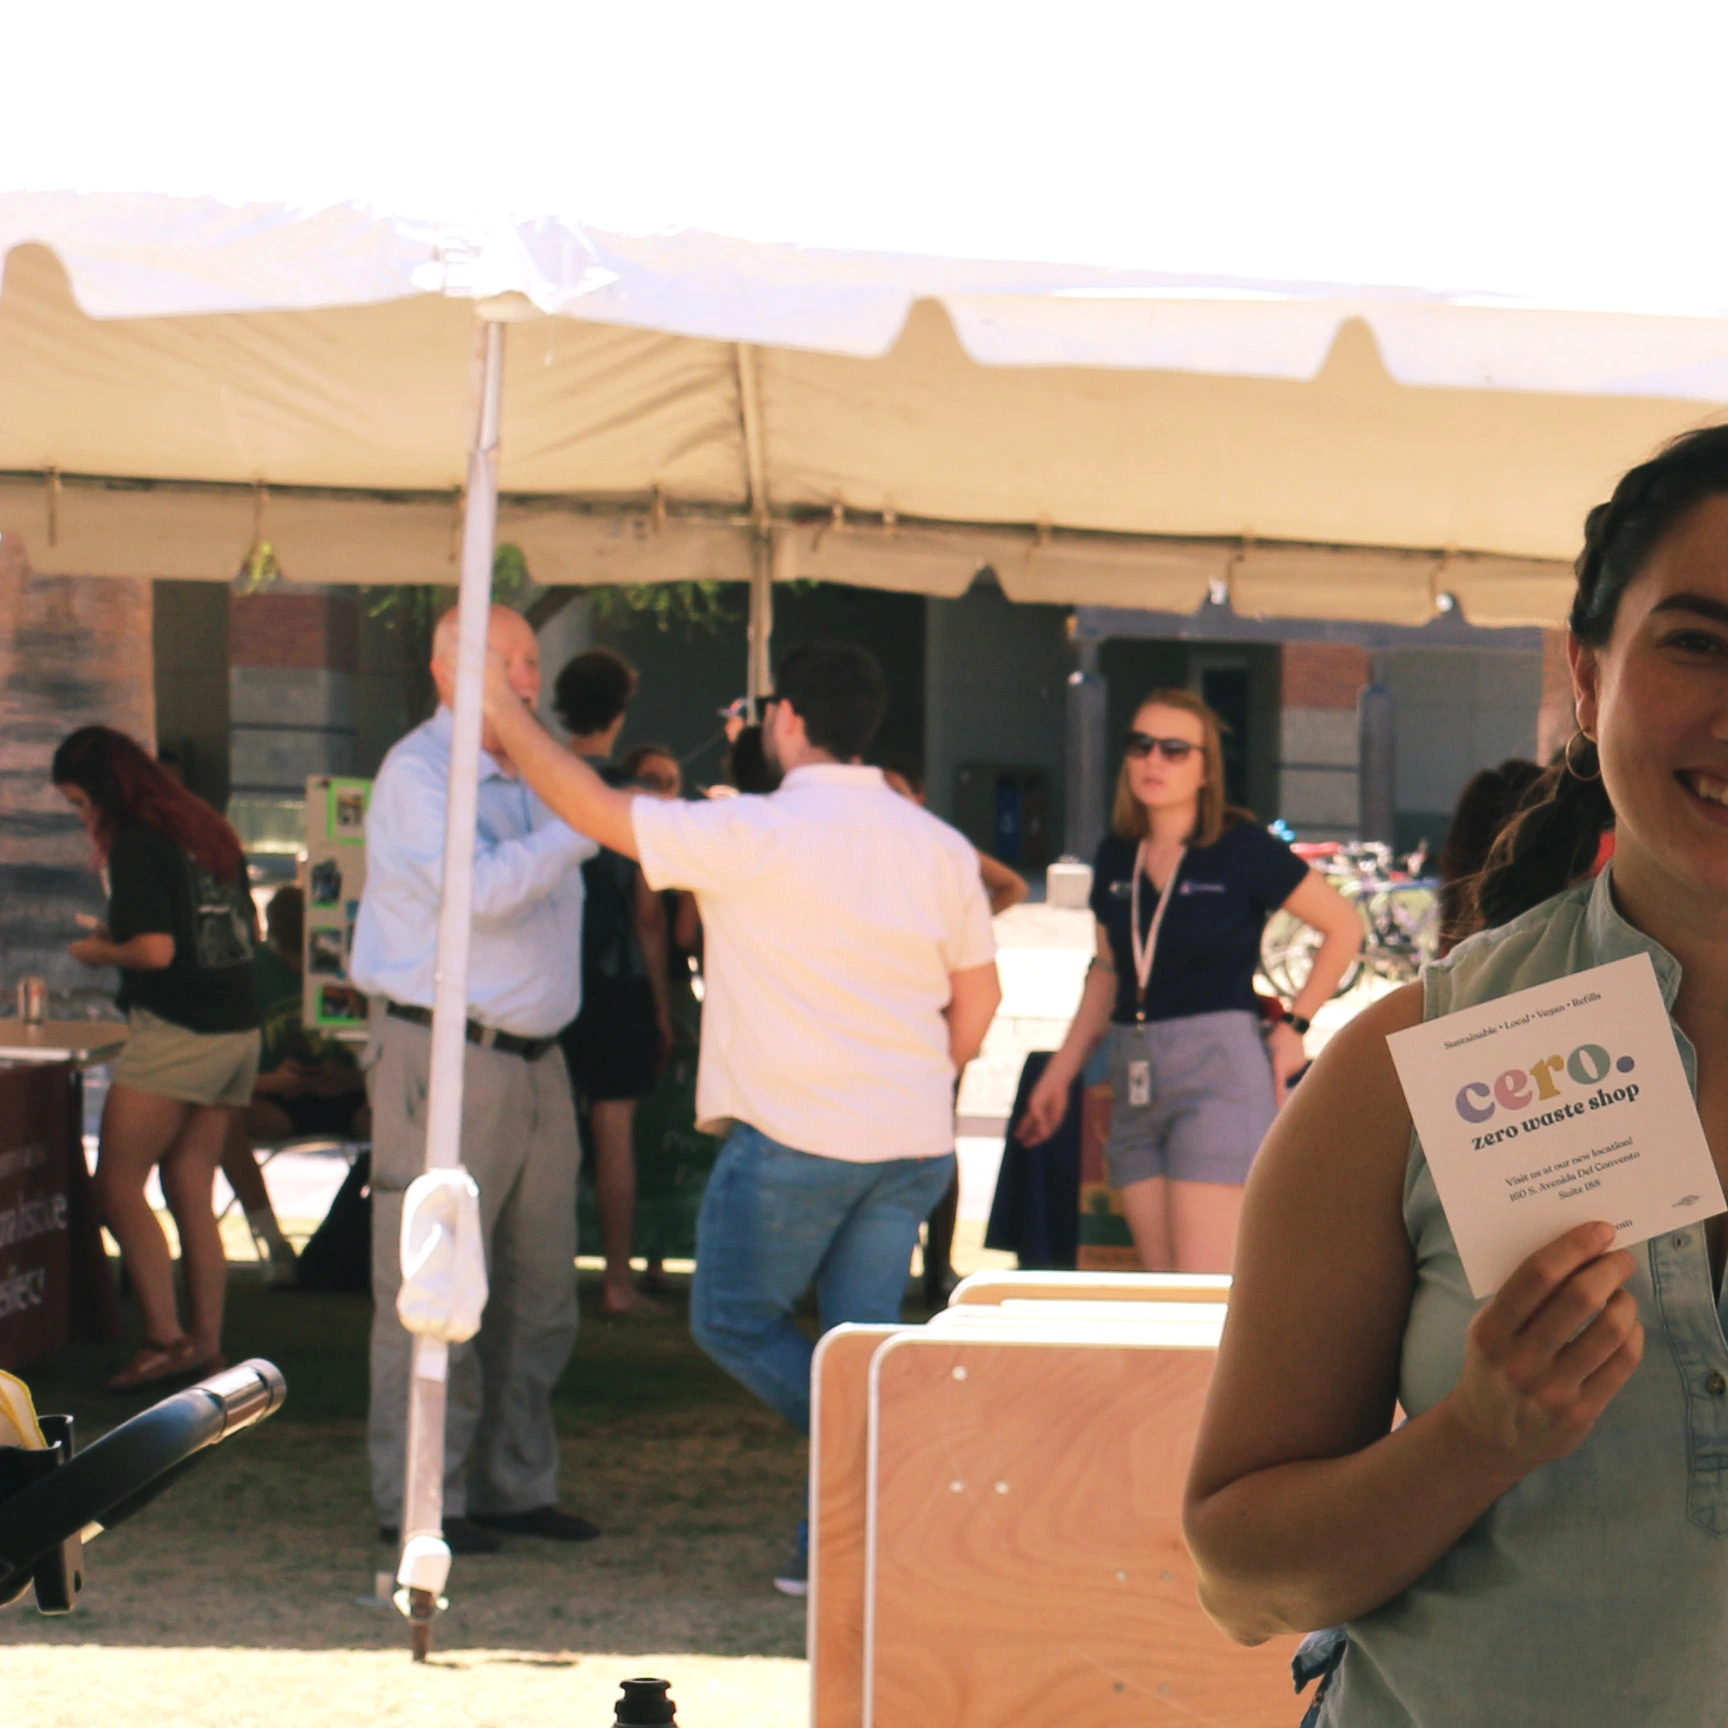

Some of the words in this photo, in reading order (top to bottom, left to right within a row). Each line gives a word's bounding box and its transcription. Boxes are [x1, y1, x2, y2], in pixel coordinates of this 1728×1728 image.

[1444, 1027, 1498, 1050] Sustainable
[1504, 1014, 1530, 1030] Local
[1572, 992, 1602, 1008] Refills
[1455, 1044, 1635, 1124] cero.
[1472, 1125, 1518, 1151] zero
[1521, 1102, 1585, 1133] waste
[1588, 1084, 1640, 1110] shop
[1506, 1174, 1529, 1187] Visit
[1531, 1171, 1542, 1180] us
[1543, 1167, 1553, 1176] at
[1554, 1161, 1570, 1171] our
[1572, 1155, 1590, 1165] new
[1528, 1187, 1538, 1196] S.
[1540, 1173, 1577, 1192] Avenida
[1578, 1166, 1594, 1178] Del
[1595, 1152, 1640, 1172] Convento
[1558, 1186, 1583, 1200] Suite
